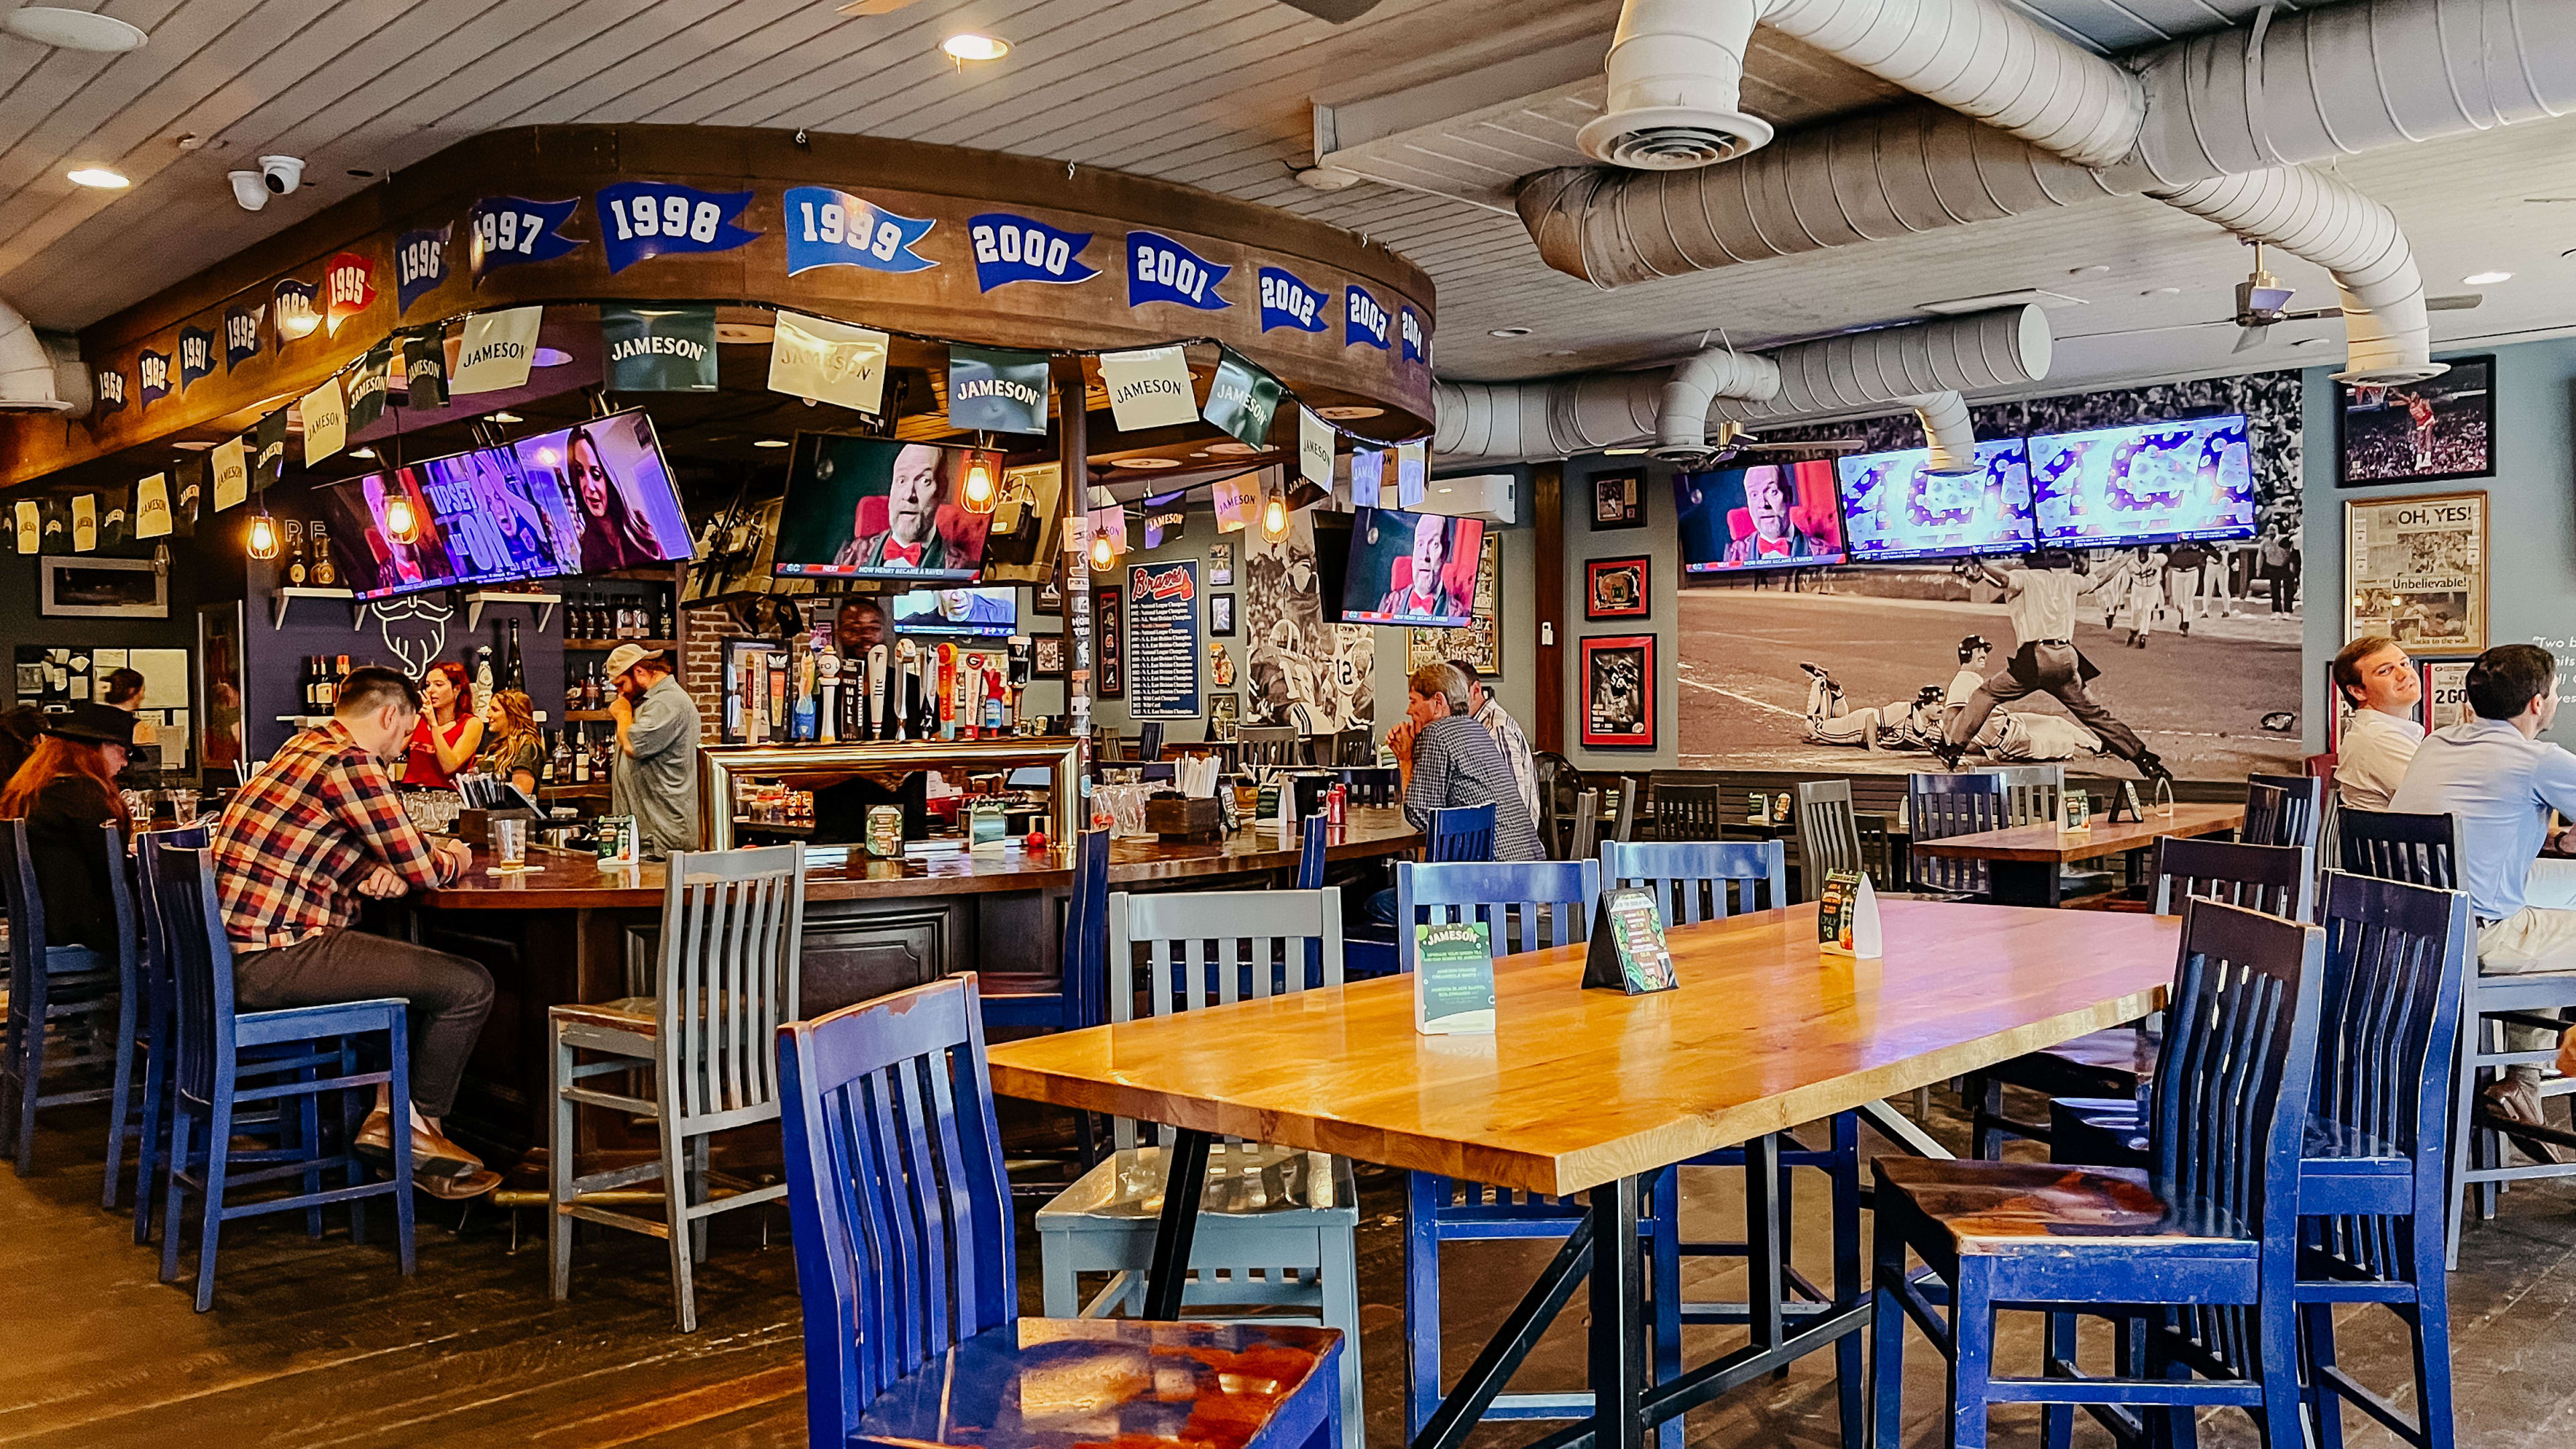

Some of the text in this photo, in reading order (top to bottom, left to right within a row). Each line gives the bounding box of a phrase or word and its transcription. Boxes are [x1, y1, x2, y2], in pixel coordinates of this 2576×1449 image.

[610, 195, 721, 244] 1998
[800, 202, 903, 262] 1999
[401, 240, 441, 286] 1996
[973, 225, 1071, 276] 2000
[330, 267, 366, 307] 1995
[1137, 245, 1208, 303] 2001
[1261, 276, 1316, 327] 2002
[1350, 292, 1387, 343] 2003
[227, 315, 256, 352] 1992
[611, 336, 707, 362] JAMESON
[183, 337, 207, 371] 1991
[463, 341, 527, 368] JAMESON
[99, 371, 123, 404] 1969
[141, 357, 166, 390] 1982
[408, 359, 441, 385] JAMESON
[351, 375, 387, 410] JAMESON
[957, 378, 1041, 407] JAMESON
[1116, 378, 1185, 404] JAMESON
[1217, 383, 1268, 427] JAMESON
[307, 411, 341, 443] JAMESON
[1303, 439, 1332, 468] JAMESON
[217, 465, 243, 490] JAMESON
[140, 498, 166, 518] JAMESON
[428, 480, 478, 515] UPSET
[1219, 494, 1256, 515] JAMESON
[1148, 513, 1185, 533] JAMESON
[2398, 506, 2471, 526] OH, YES!
[822, 565, 839, 573] NEXT
[1132, 565, 1183, 602] Braves
[2392, 577, 2467, 590] Unbelievable!
[2454, 636, 2469, 644] wall
[1336, 658, 1354, 686] 12
[846, 686, 855, 724] MULE
[2435, 689, 2445, 704] 2
[1428, 930, 1480, 946] JAMESON
